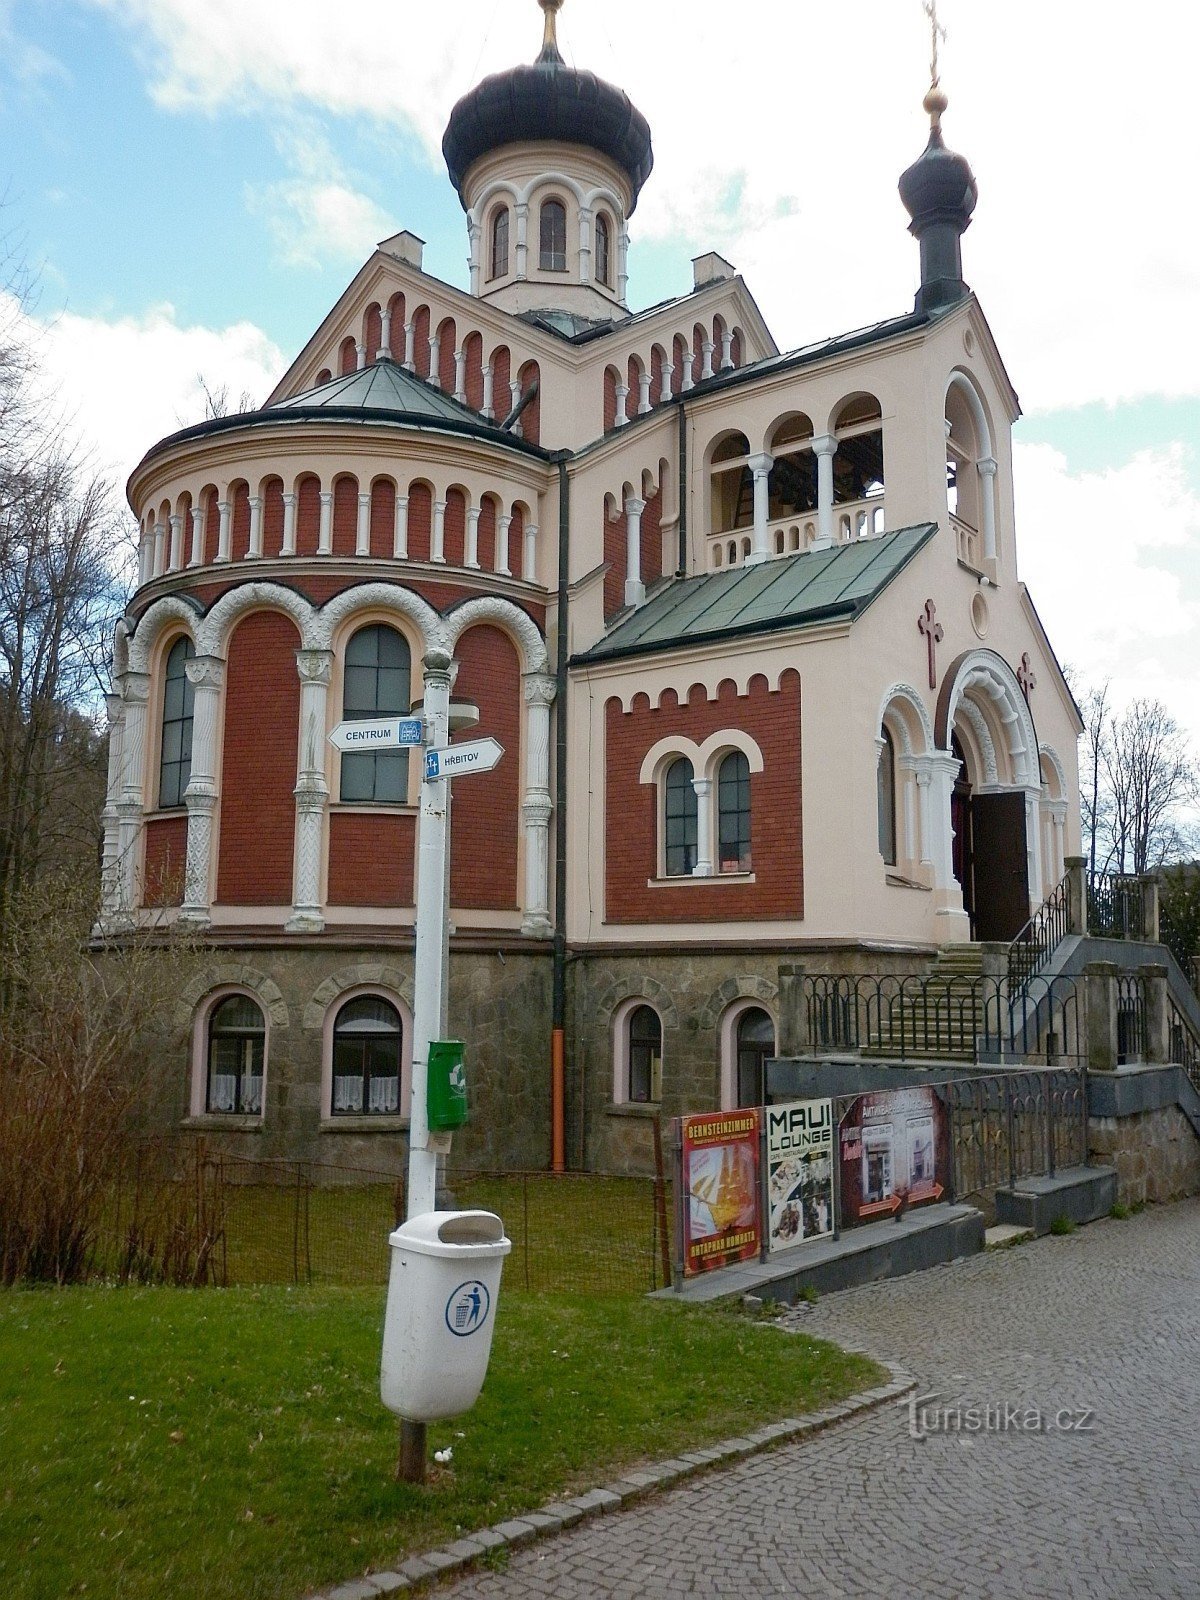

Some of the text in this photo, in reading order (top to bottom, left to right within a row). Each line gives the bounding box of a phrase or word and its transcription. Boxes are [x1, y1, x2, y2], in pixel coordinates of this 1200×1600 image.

[345, 729, 391, 741] CENTRUM
[444, 752, 479, 767] HŘBITOV
[688, 1117, 754, 1139] BERNSTEINZIMMER
[770, 1105, 830, 1136] MAUI
[770, 1129, 831, 1152] LOUNGE
[691, 1238, 725, 1258] ЯНТАРНАЯ
[726, 1230, 755, 1248] КОМНАТА
